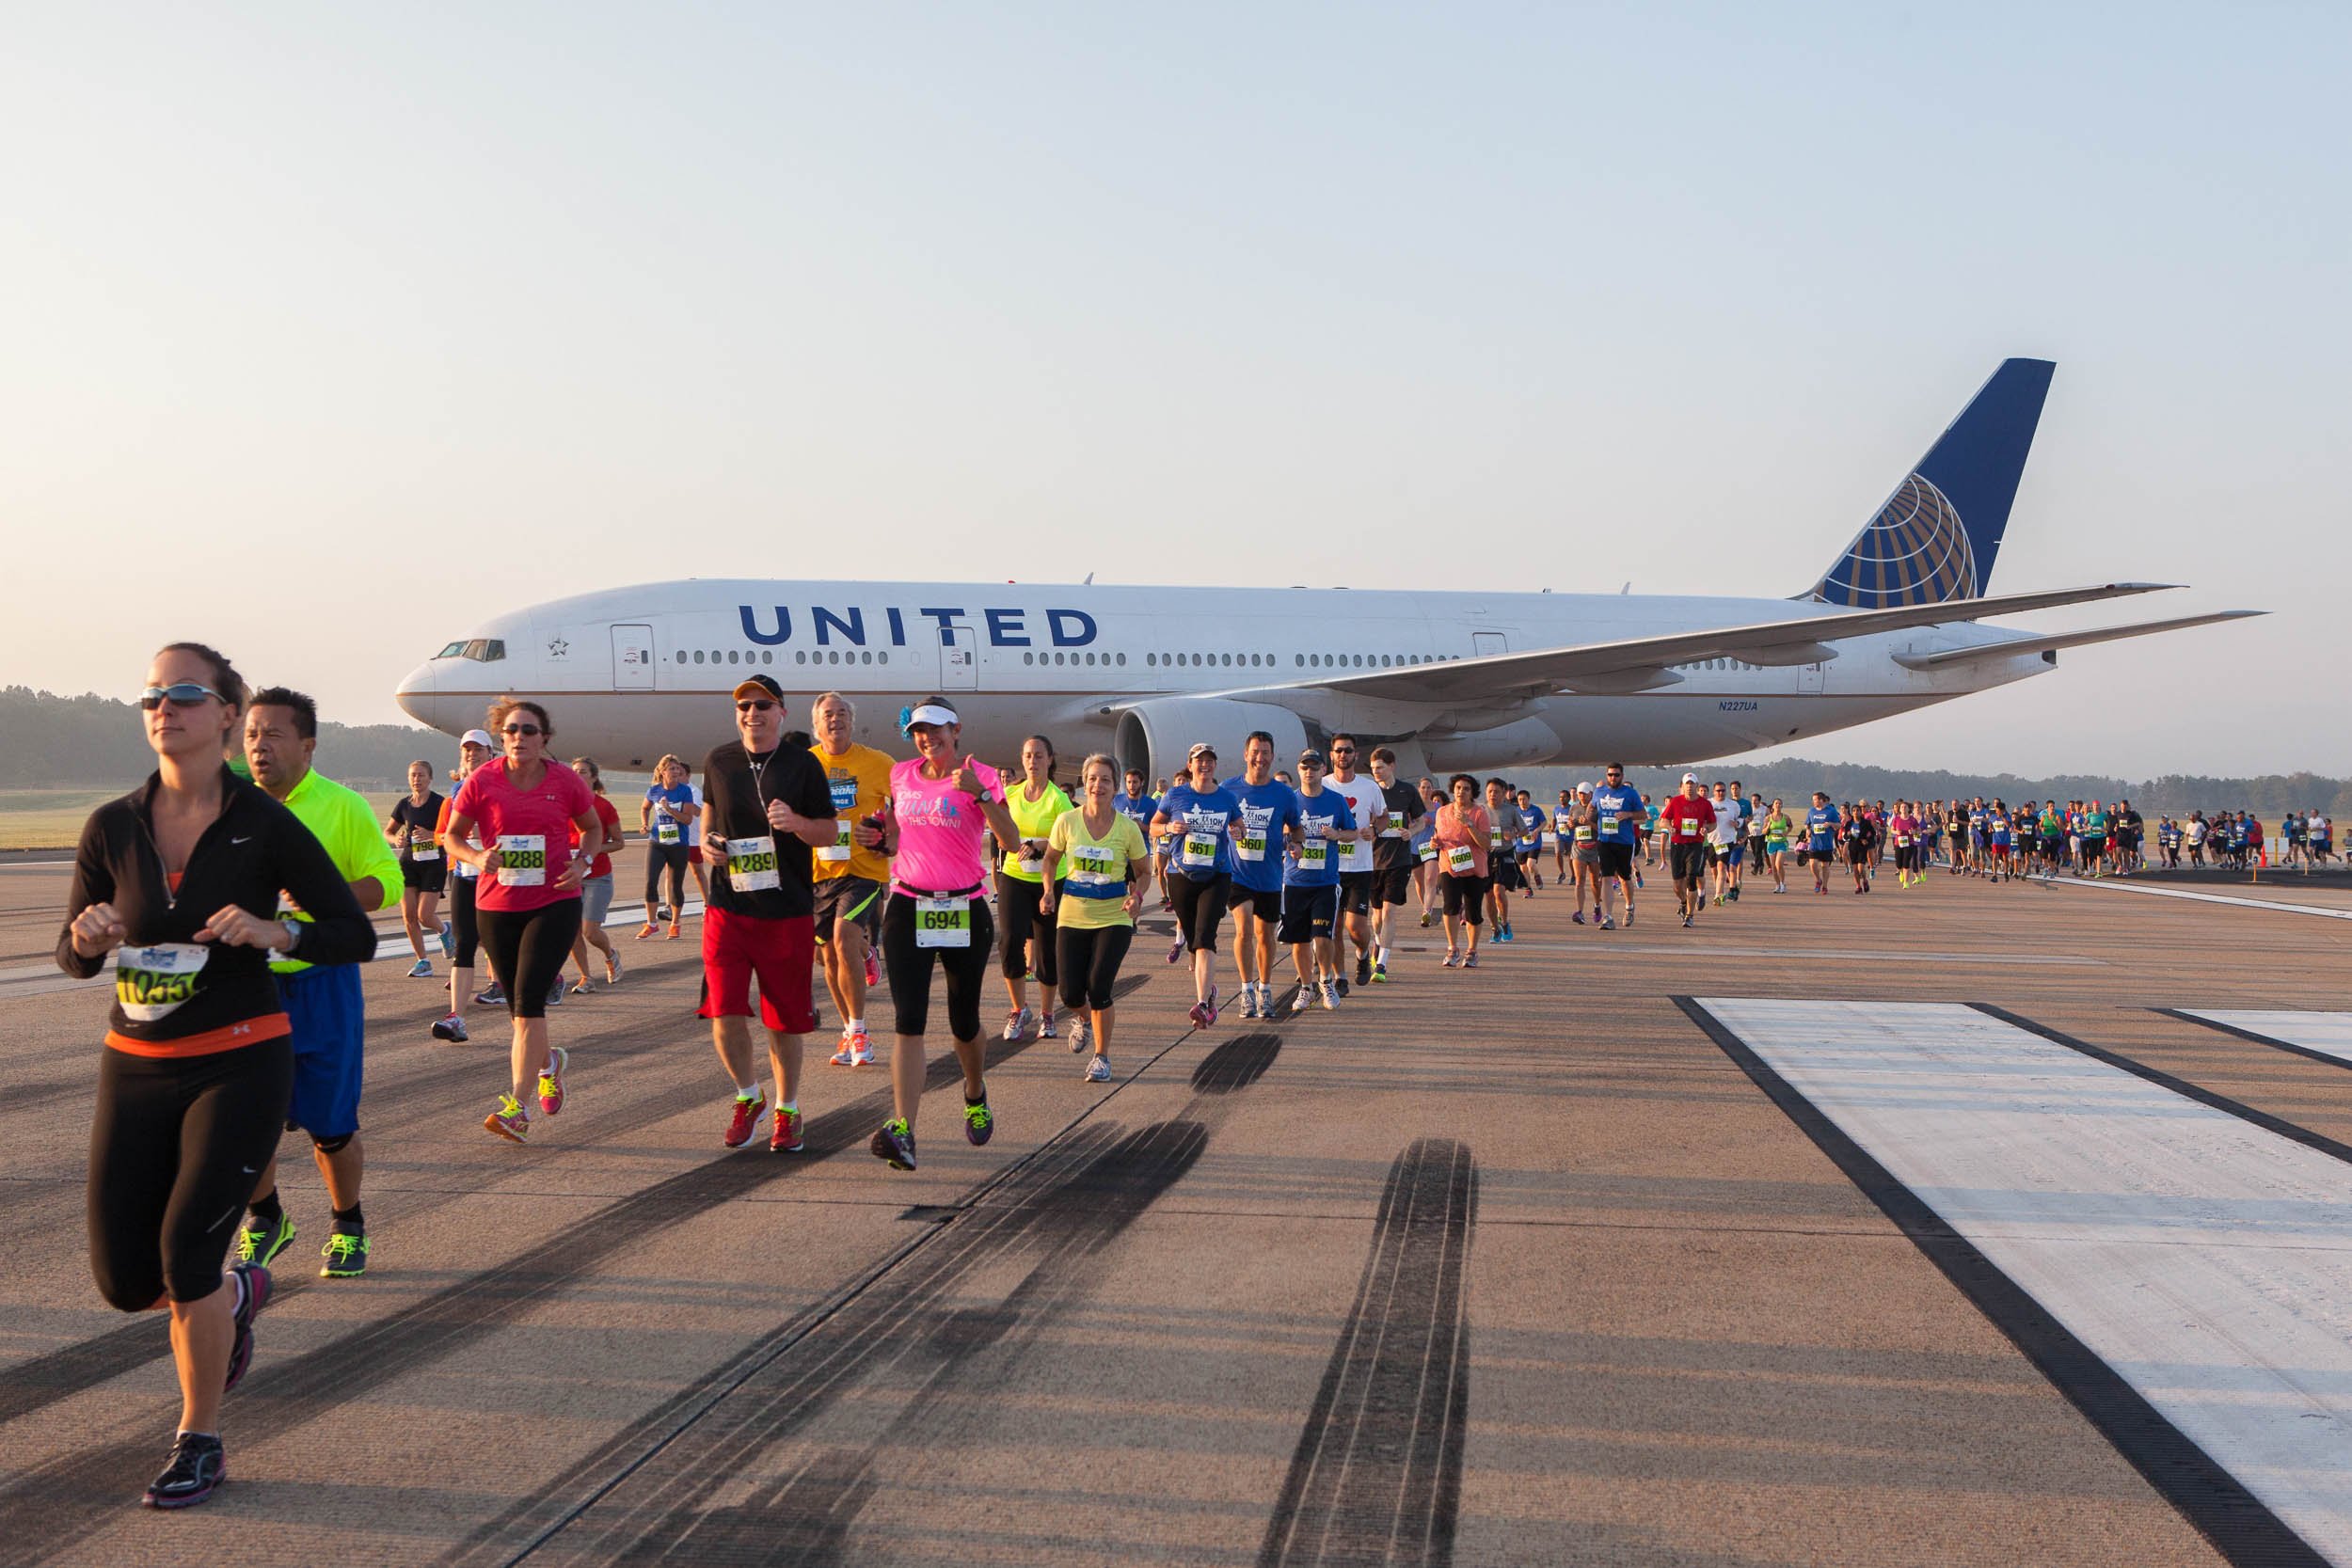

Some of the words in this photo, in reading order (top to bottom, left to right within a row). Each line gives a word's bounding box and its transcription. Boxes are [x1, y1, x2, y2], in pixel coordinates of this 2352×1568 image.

[739, 606, 1098, 646] UNITED
[1719, 702, 1758, 712] N227UA
[908, 816, 927, 827] THIS
[1209, 818, 1224, 827] 10K
[1254, 814, 1269, 822] 10K
[661, 831, 676, 839] 846
[416, 842, 434, 851] 798
[1188, 842, 1210, 855] 961
[1240, 838, 1261, 850] 960
[500, 850, 543, 868] 1288
[1305, 848, 1326, 860] 331
[1451, 852, 1471, 865] 1609
[729, 852, 775, 873] 1289
[1080, 858, 1104, 873] 121
[925, 911, 961, 929] 694
[118, 971, 197, 1006] 1055
